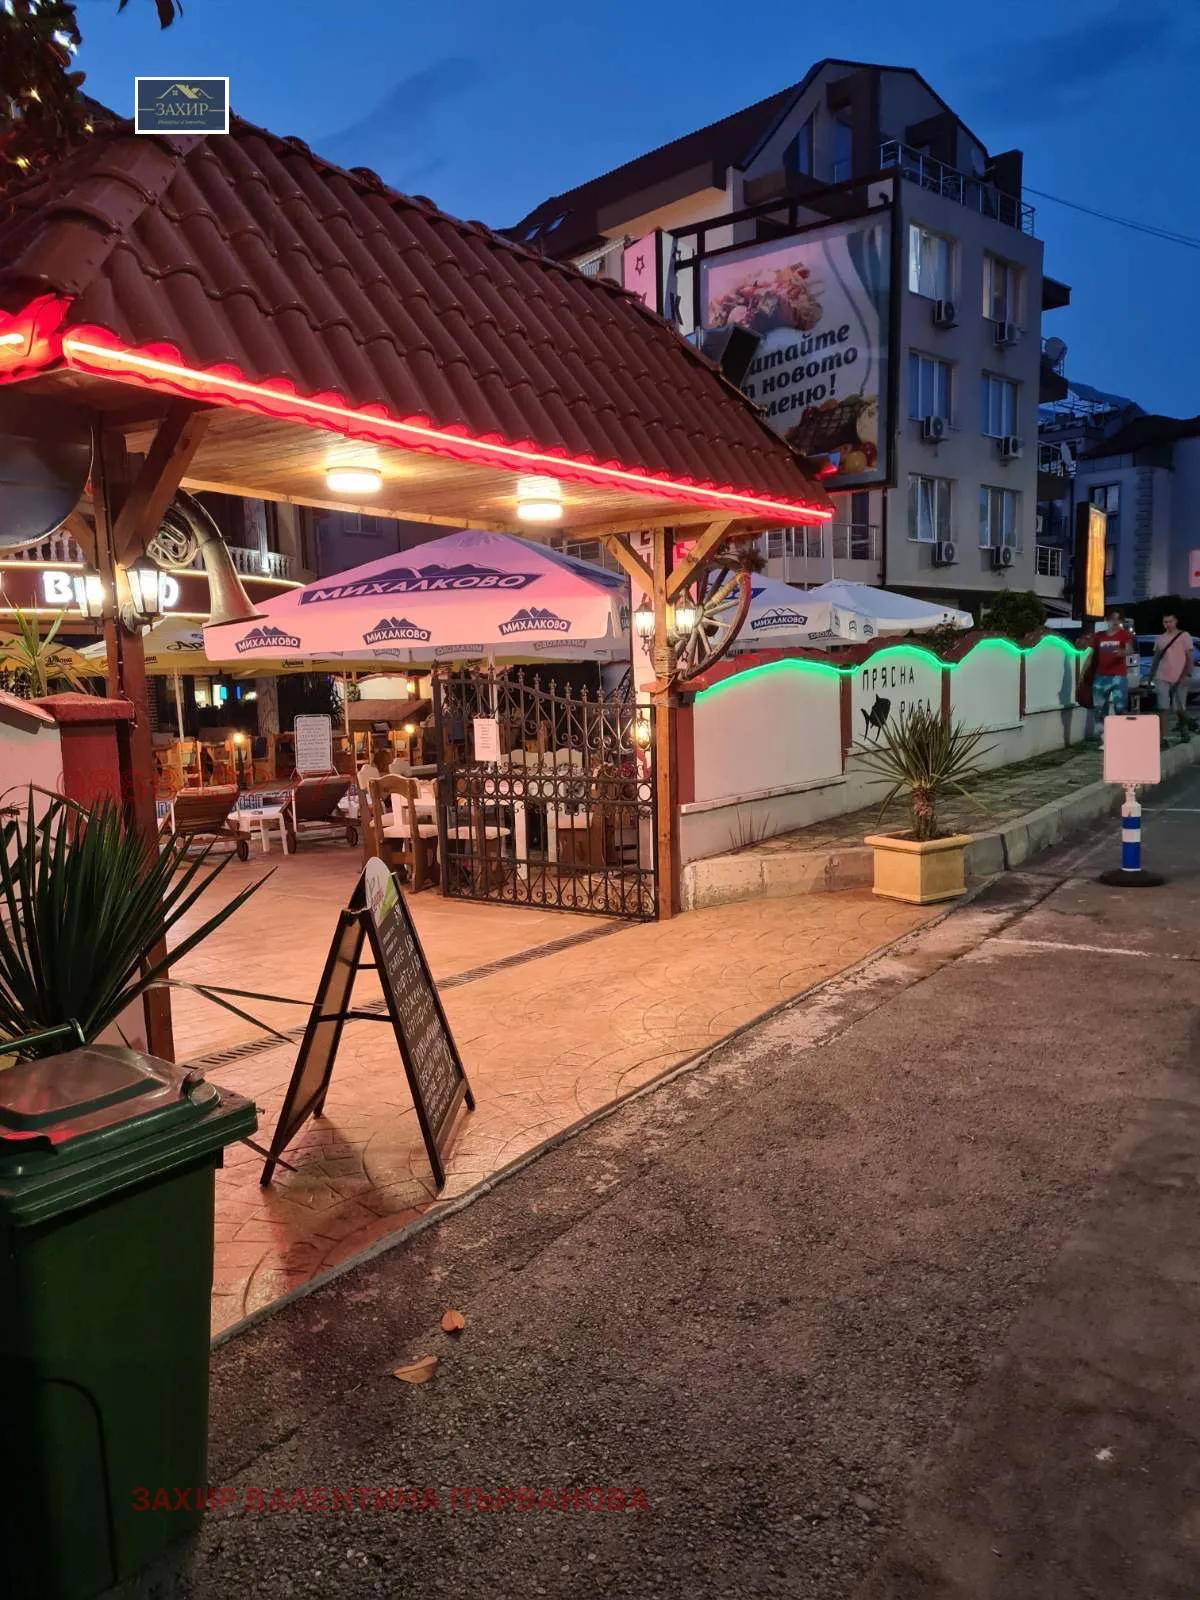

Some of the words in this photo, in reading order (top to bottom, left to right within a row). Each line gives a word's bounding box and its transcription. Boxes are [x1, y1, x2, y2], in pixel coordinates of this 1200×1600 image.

[747, 324, 850, 377] итайте
[762, 347, 858, 394] новото
[309, 574, 526, 602] МИХАЛКОВО
[502, 619, 568, 634] МИХАЛКОВО
[754, 615, 805, 629] МИХАЛКОВО
[238, 636, 299, 651] МИХАЛКОВО
[365, 627, 428, 643] МИХАЛКОВО
[862, 666, 915, 691] ПРЯСНА
